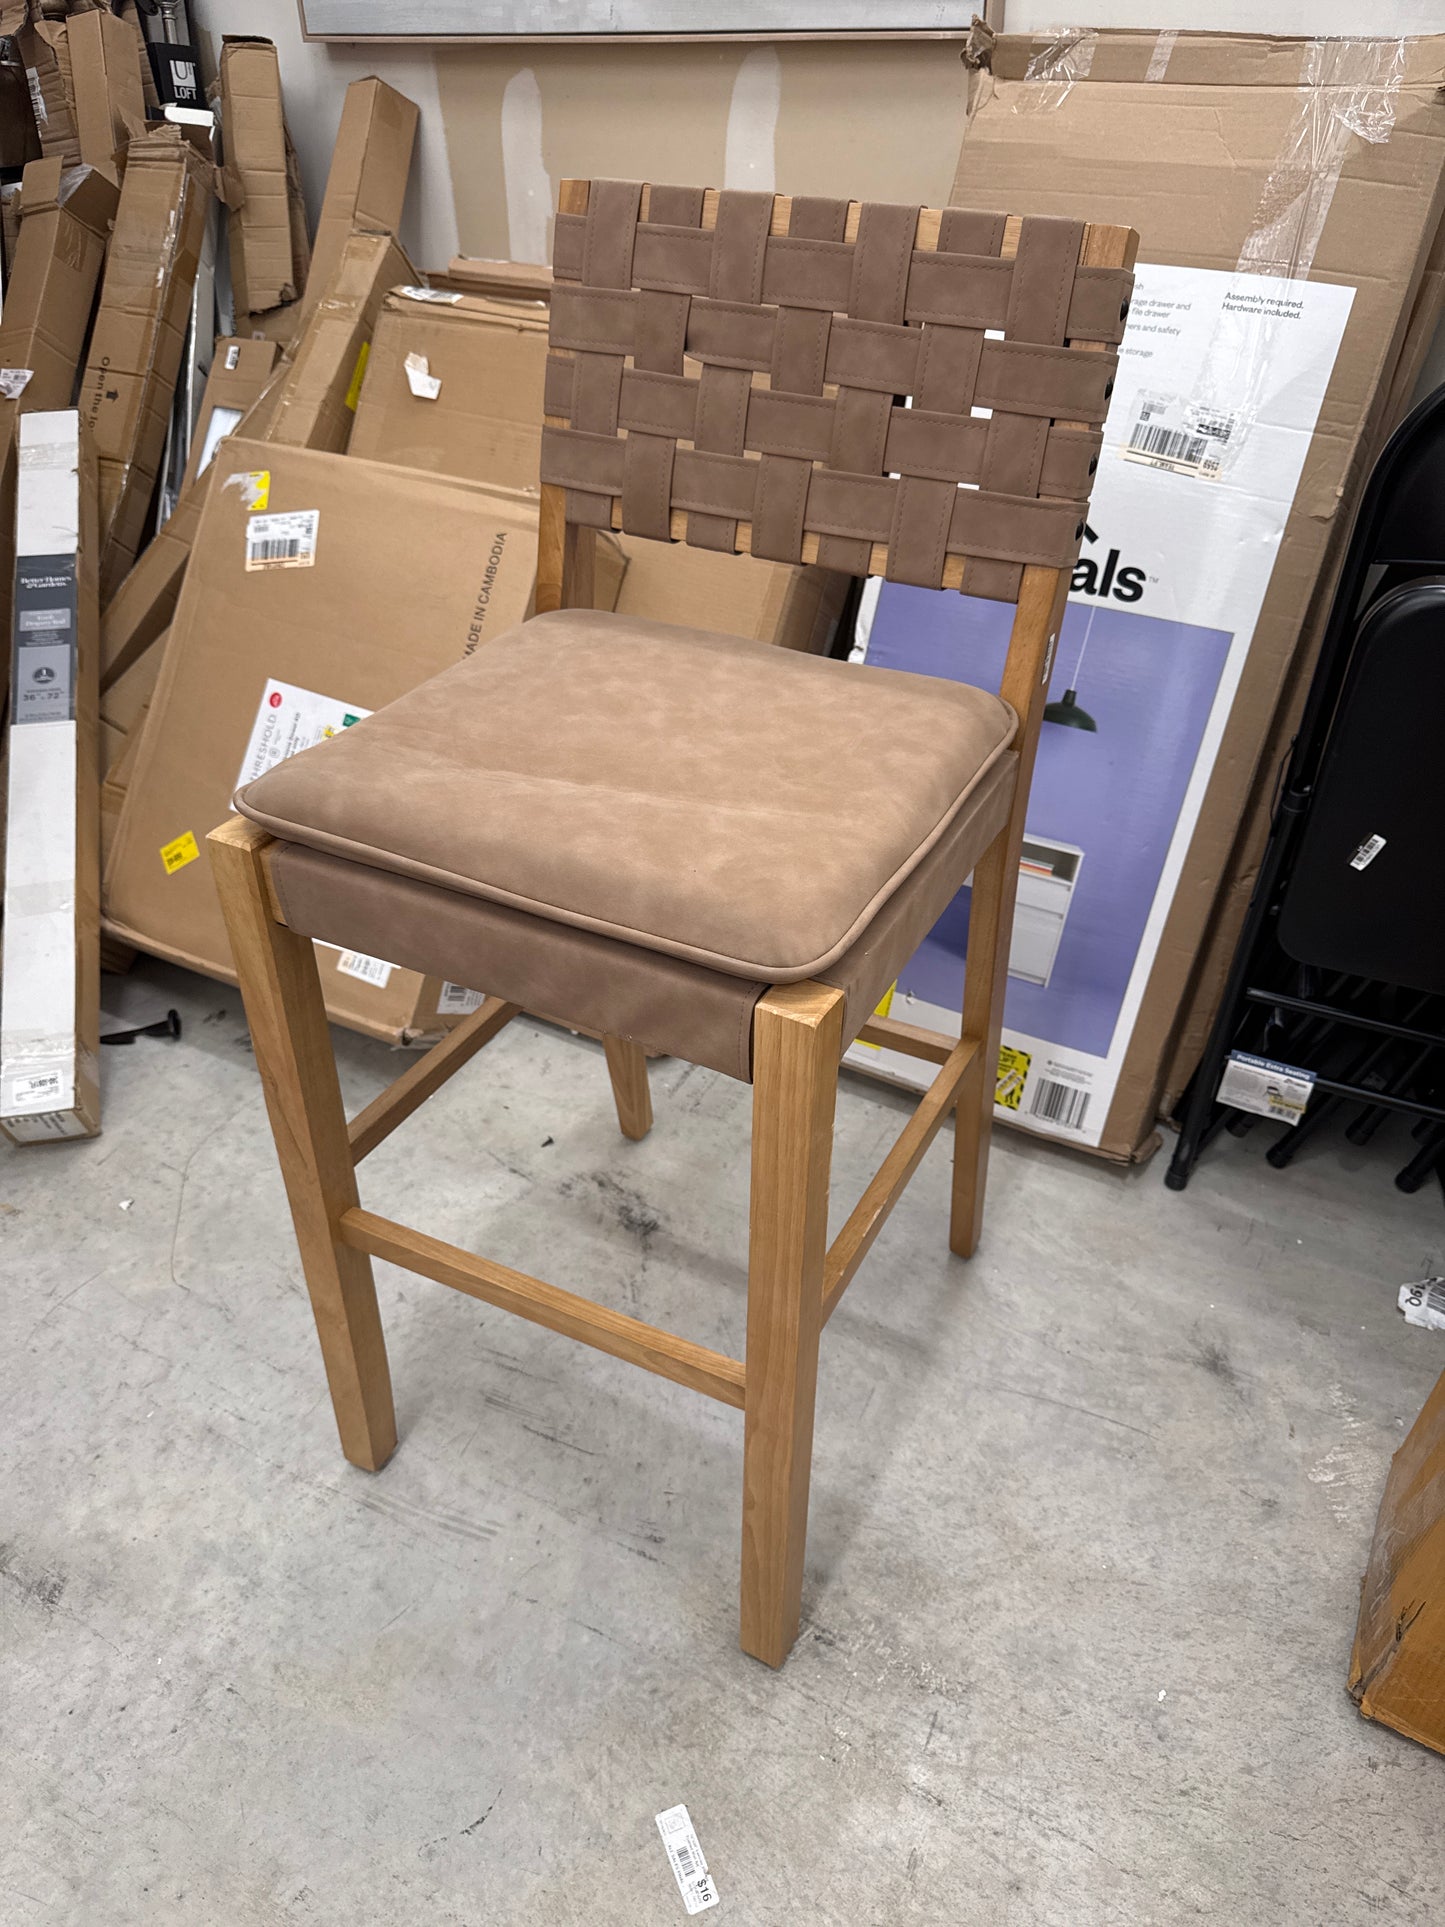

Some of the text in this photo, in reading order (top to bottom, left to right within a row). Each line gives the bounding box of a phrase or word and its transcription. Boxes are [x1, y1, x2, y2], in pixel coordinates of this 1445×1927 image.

[174, 86, 197, 100] LOFT
[1148, 299, 1175, 309] drawer
[1175, 303, 1192, 311] and
[1224, 292, 1304, 309] Assembly required.
[1144, 309, 1170, 318] drawer
[1221, 302, 1301, 319] Hardware included.
[1157, 326, 1181, 336] safety
[1125, 348, 1153, 358] storage
[97, 356, 110, 390] Open
[91, 393, 103, 413] the
[478, 532, 507, 605] CAMBODIA
[473, 606, 486, 622] IN
[1236, 1054, 1265, 1068] Portable
[1265, 1062, 1284, 1073] Extra
[1284, 1067, 1311, 1080] Seating
[697, 1879, 712, 1902] $16
